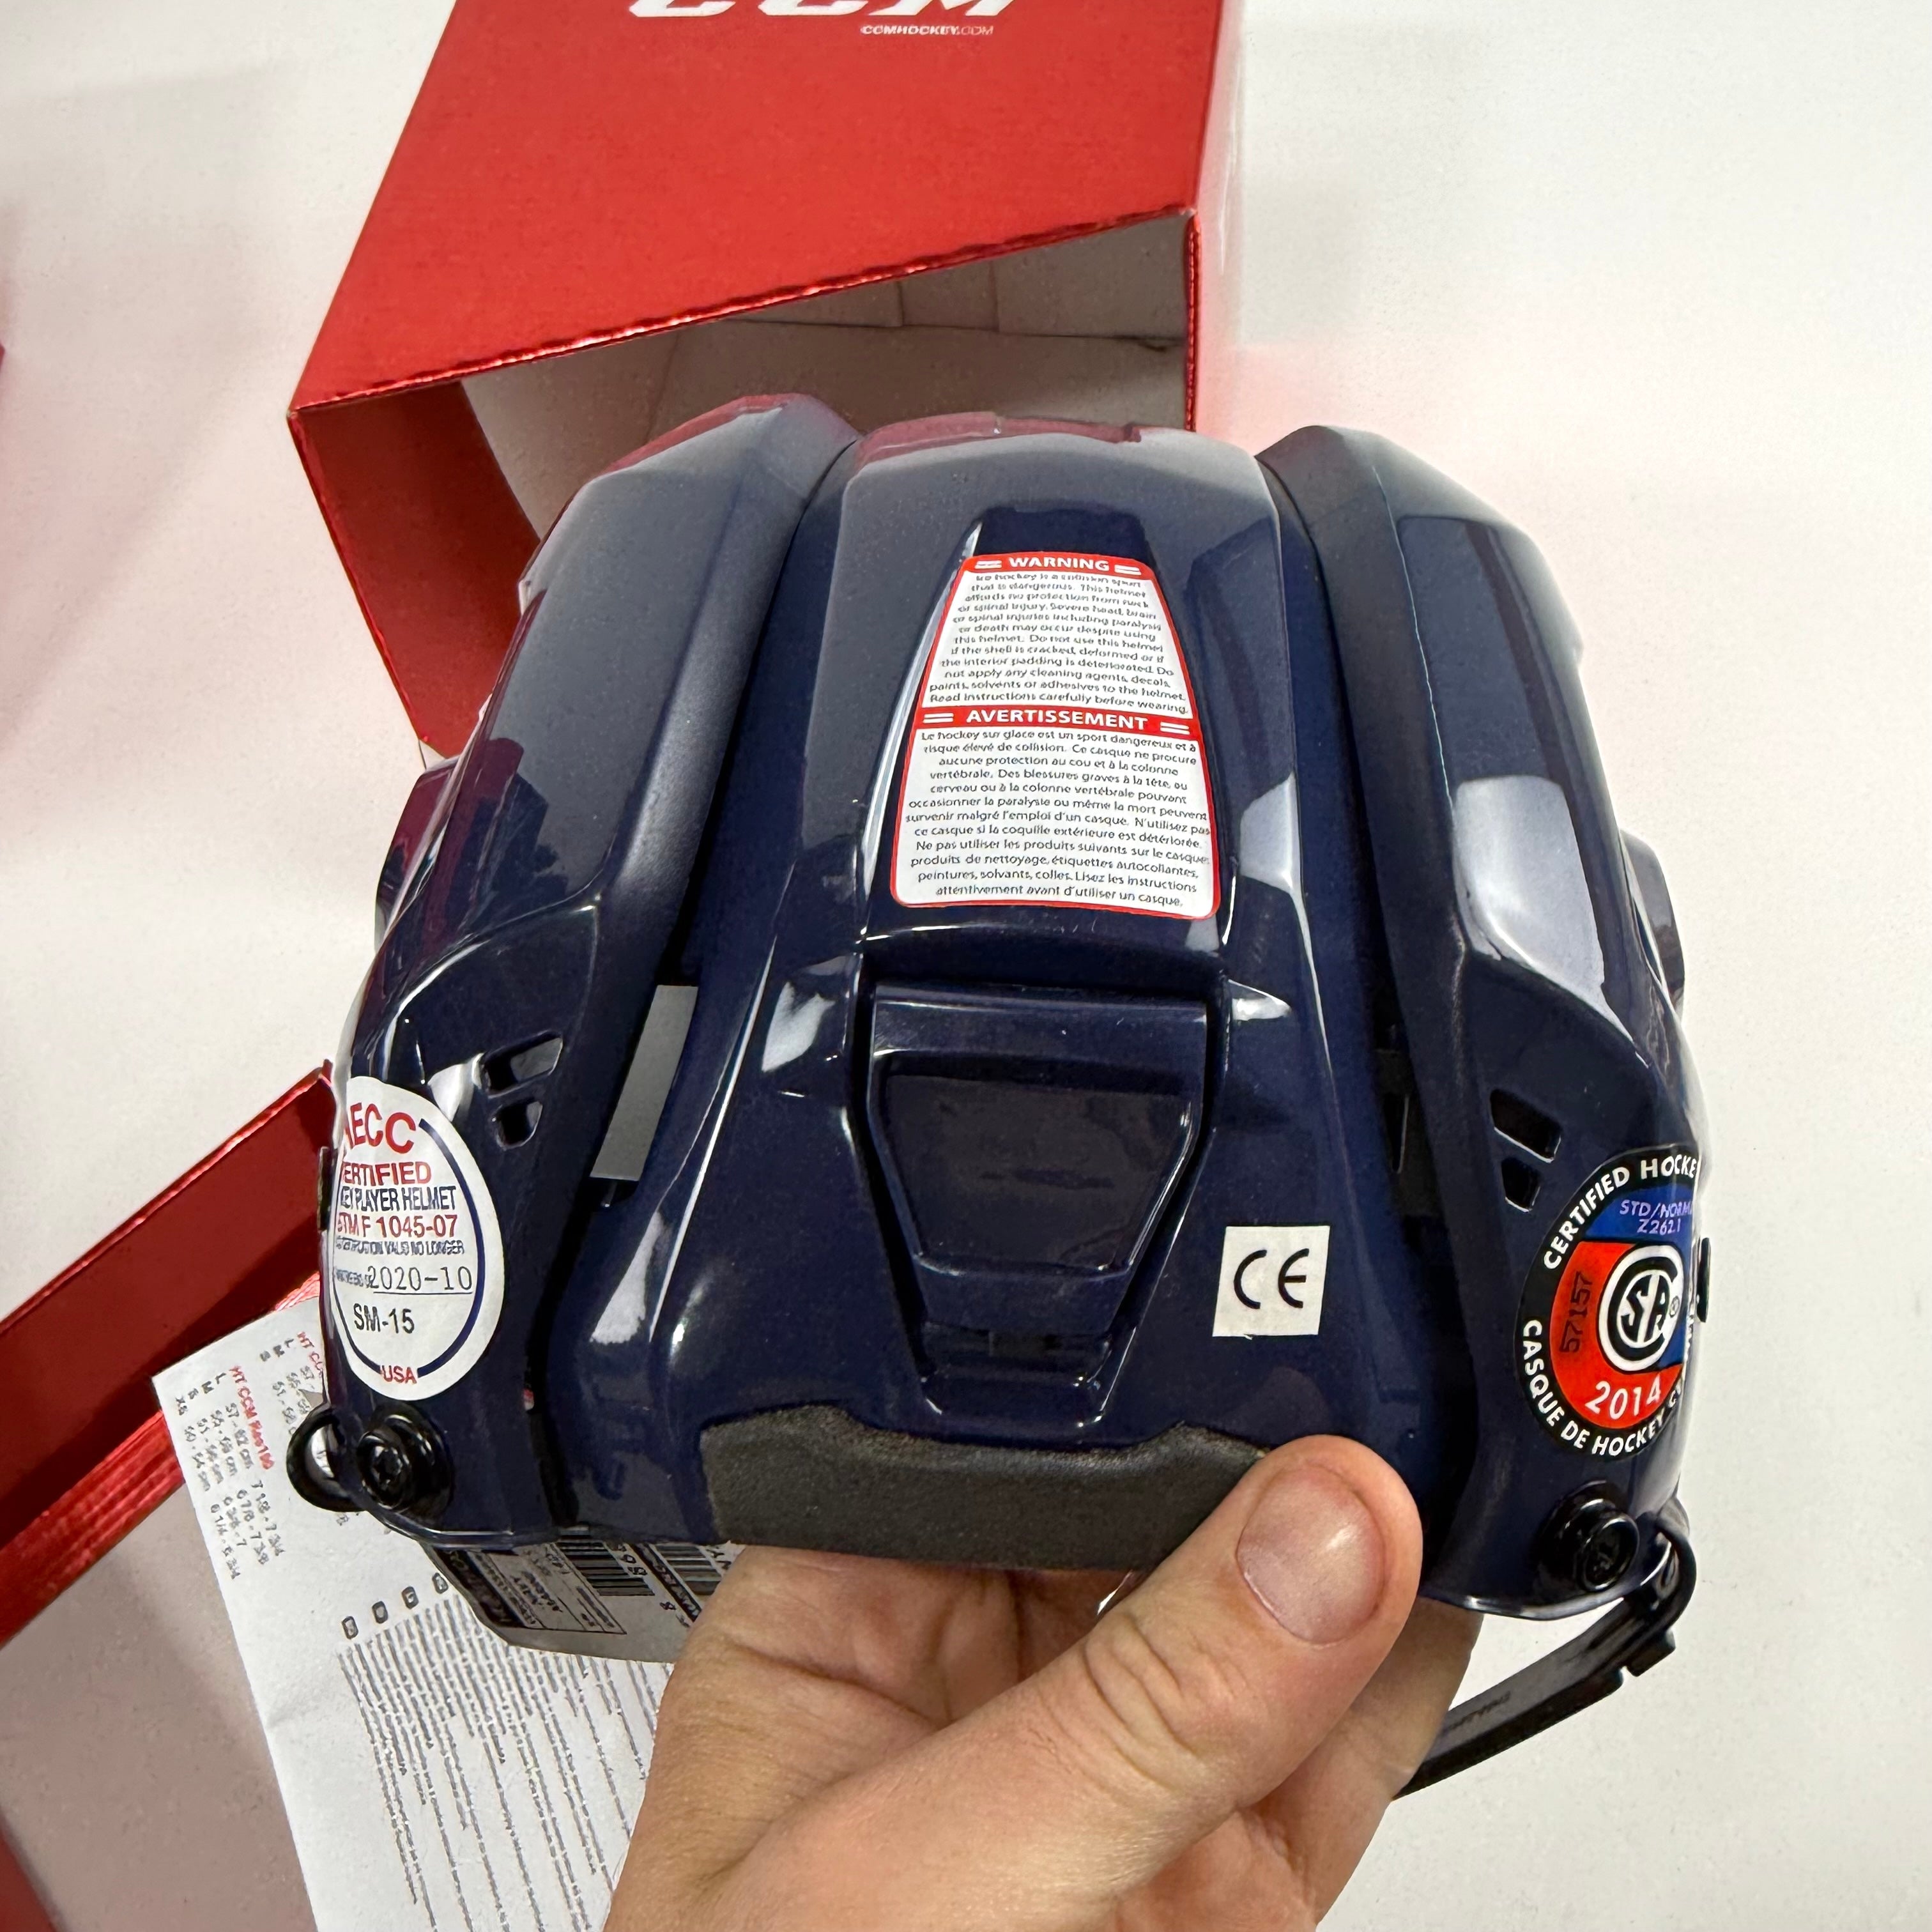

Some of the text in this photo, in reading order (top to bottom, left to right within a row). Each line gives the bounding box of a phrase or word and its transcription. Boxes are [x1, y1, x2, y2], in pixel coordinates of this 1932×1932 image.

[1008, 556, 1110, 572] WARNING
[965, 709, 1149, 732] AVERTISSEMENT
[344, 1102, 417, 1154] ECC
[342, 1162, 432, 1186] ERTIFIED
[401, 1185, 457, 1211] HELMET
[1543, 1154, 1698, 1270] CERTIFIED HOCKE
[362, 1215, 371, 1238] F
[376, 1214, 458, 1238] 1045-07
[367, 1265, 473, 1292] 2020-10
[1233, 1248, 1310, 1310] CE
[353, 1302, 415, 1334] SM-15
[1559, 1271, 1593, 1354] 57157
[381, 1364, 418, 1386] USA
[1522, 1319, 1665, 1457] CASQUE DE HOCKEY
[1584, 1374, 1662, 1420] 2014
